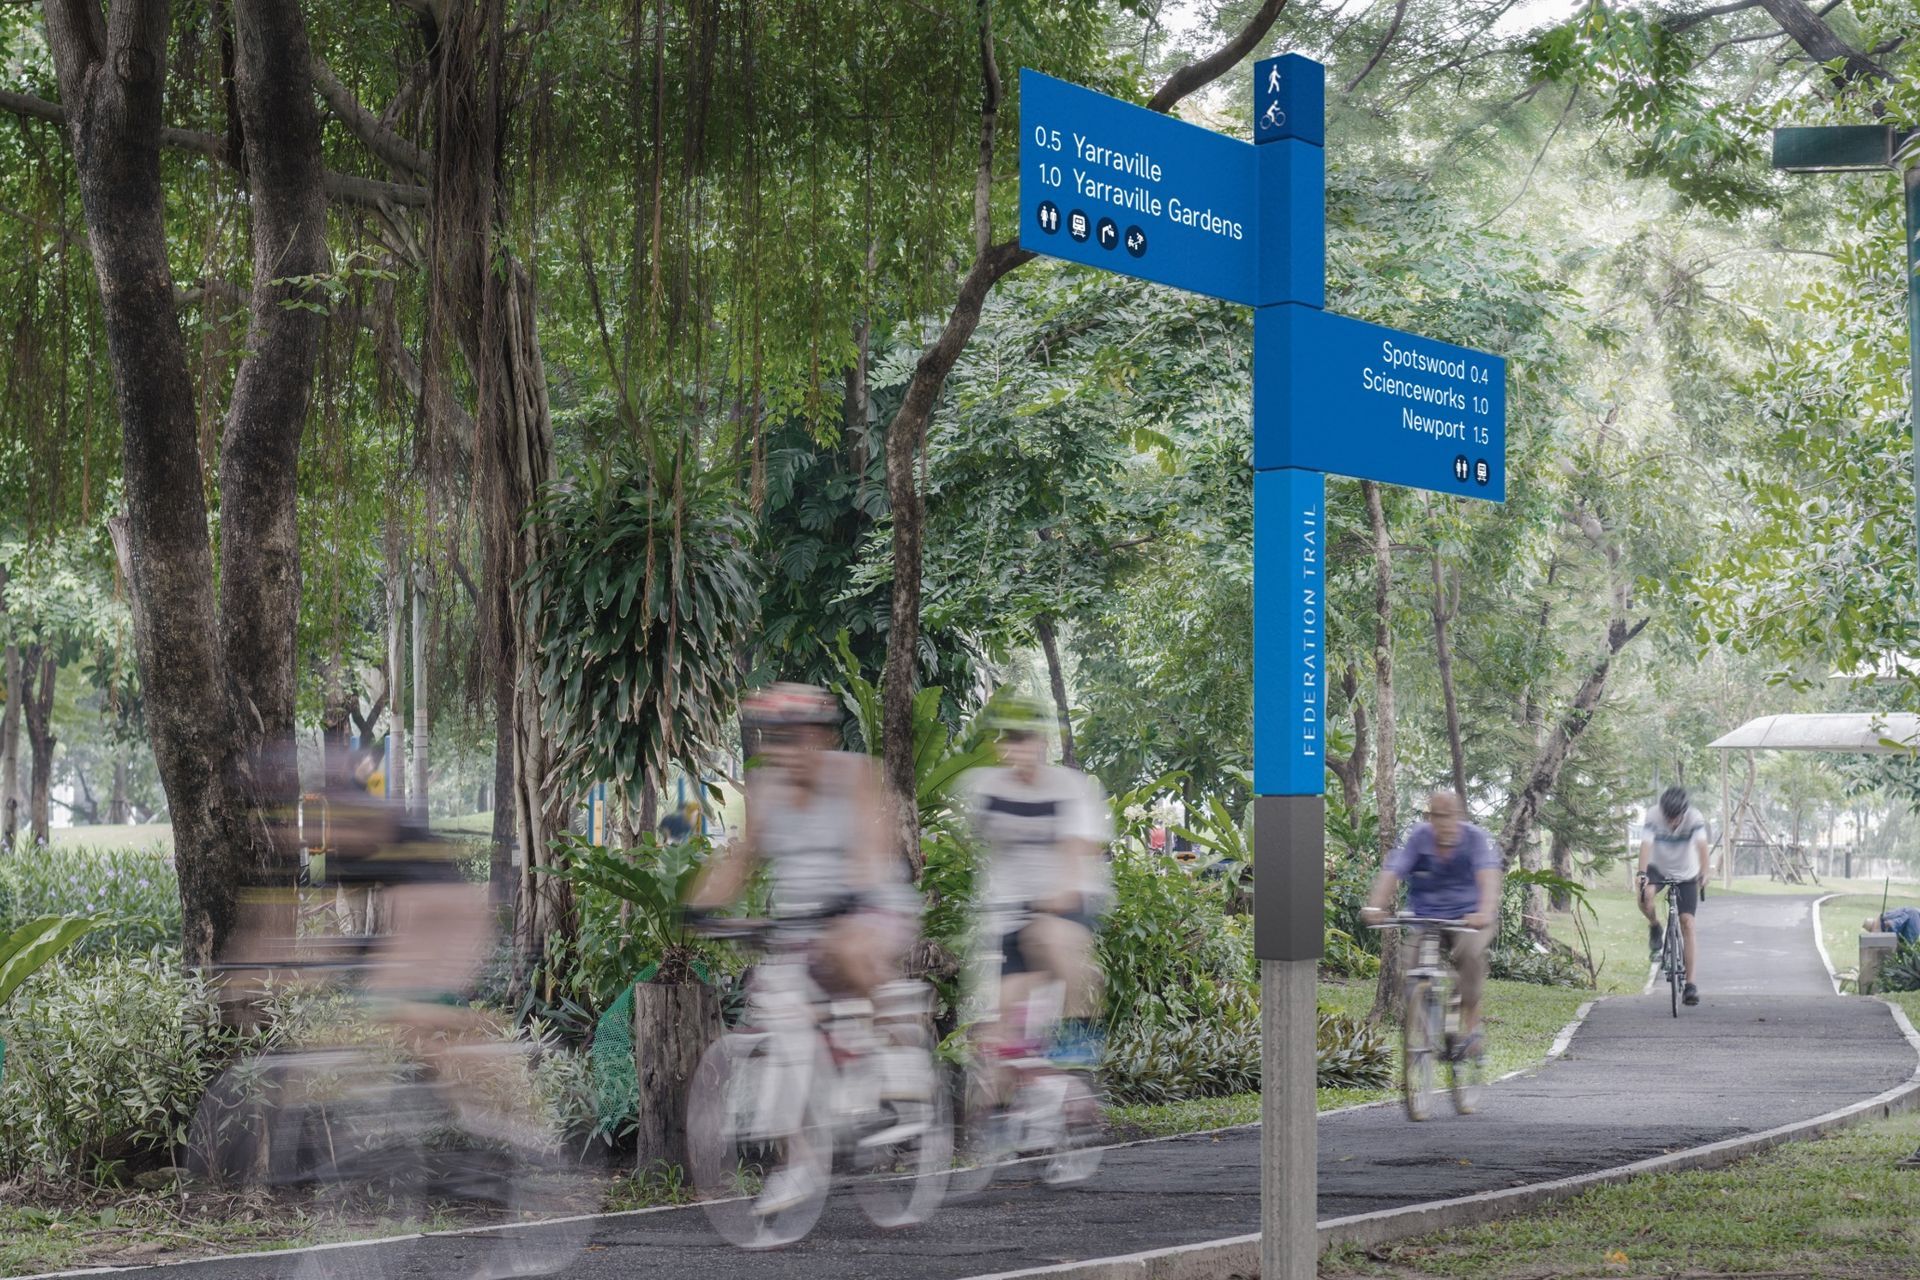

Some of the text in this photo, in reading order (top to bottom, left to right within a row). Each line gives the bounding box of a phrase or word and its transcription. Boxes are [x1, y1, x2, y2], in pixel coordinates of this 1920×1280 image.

[1035, 126, 1162, 181] 0.5 Yarraville
[1039, 163, 1243, 240] 1.0 Yarraville Gardens
[1382, 341, 1489, 385] Spotswood 0.4
[1363, 367, 1489, 415] Scienceworks 1.0
[1402, 407, 1489, 445] Newport 1.5
[1303, 503, 1316, 756] FEDERATION TRAIL
